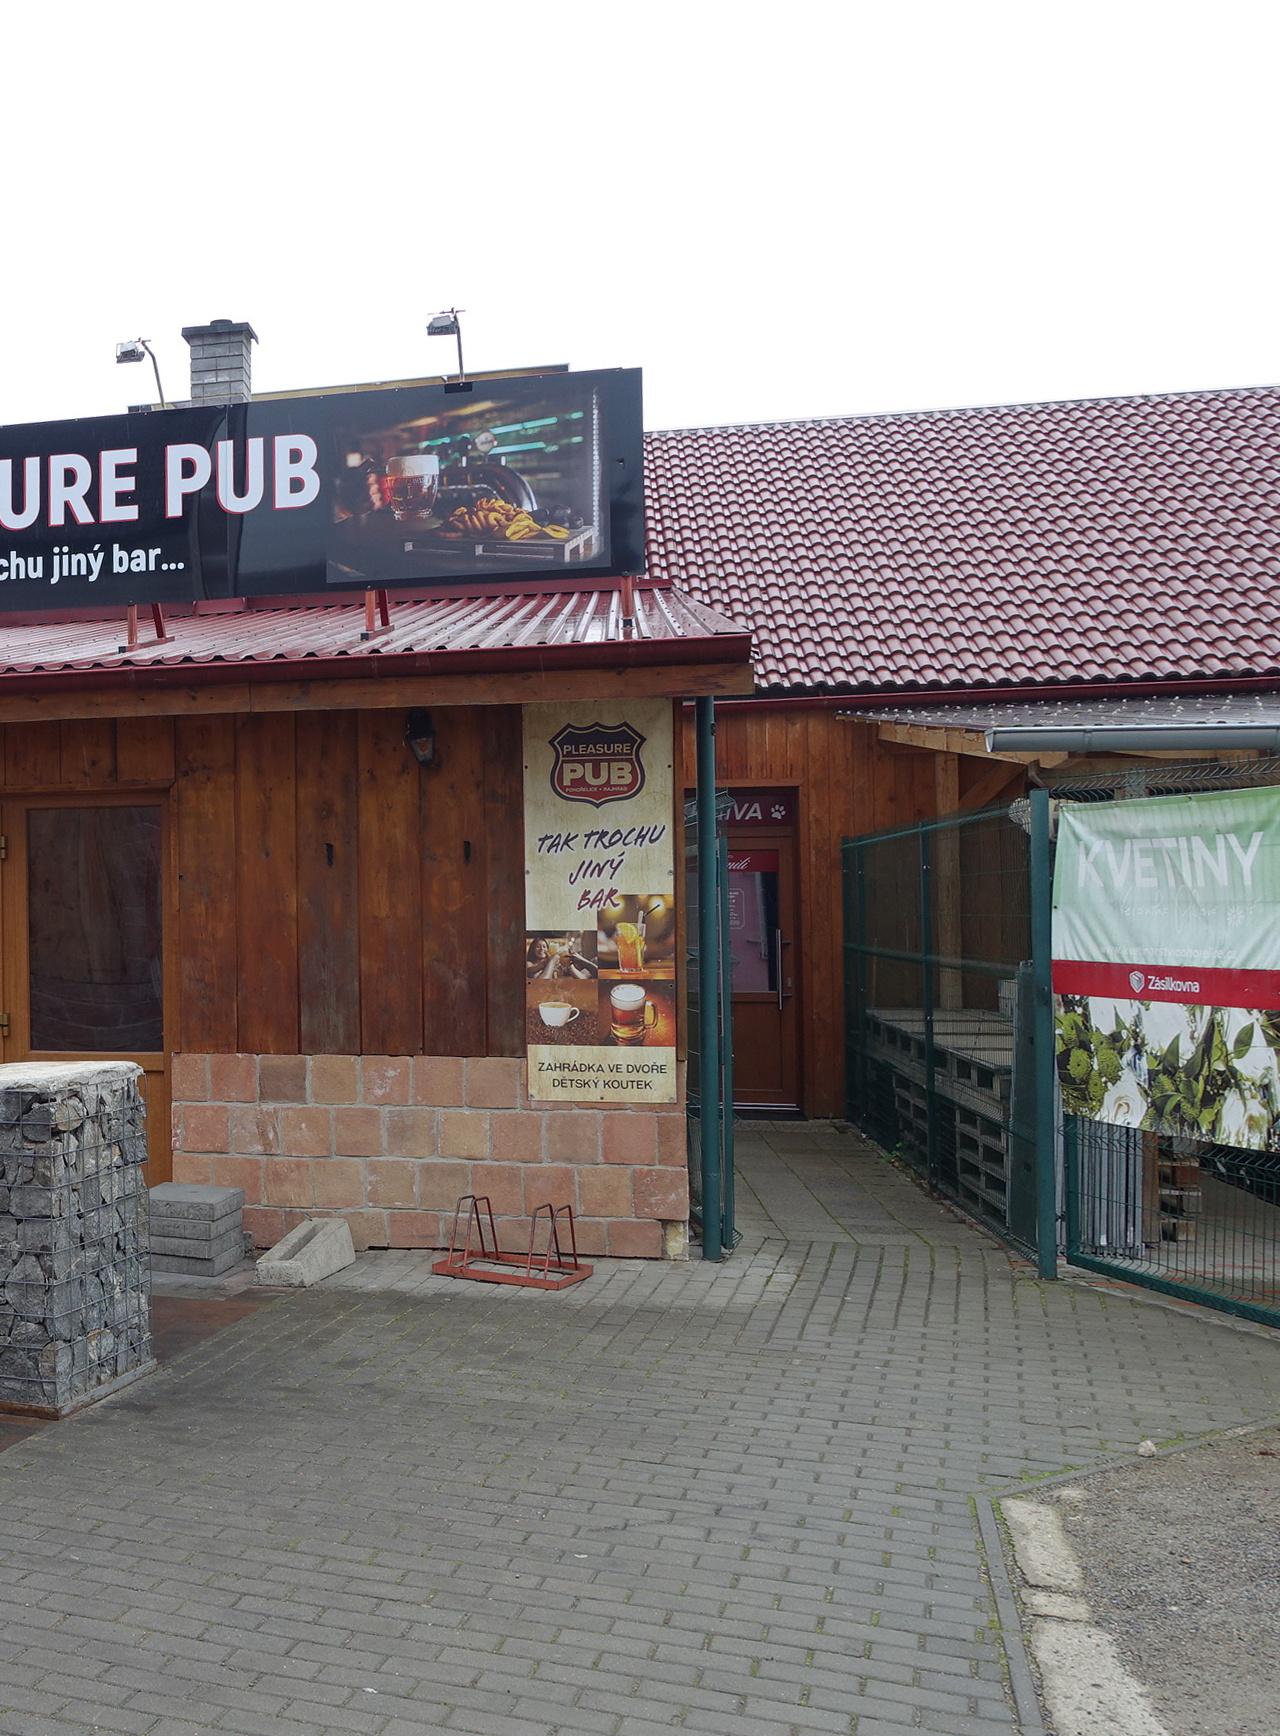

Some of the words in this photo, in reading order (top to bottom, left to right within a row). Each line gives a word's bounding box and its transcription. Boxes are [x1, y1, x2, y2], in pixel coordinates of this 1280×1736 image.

[164, 433, 321, 519] PUB
[51, 546, 106, 583] jiný
[113, 542, 185, 575] bar...
[563, 743, 631, 756] PLEASURE
[563, 761, 633, 786] PUB
[538, 832, 579, 853] TAK
[583, 825, 666, 850] TROCHU
[569, 851, 625, 885] JINÝ
[577, 887, 620, 911] BAR
[1147, 975, 1200, 993] Zásilkovna
[538, 1060, 605, 1073] ZAHRÁDKA
[607, 1064, 623, 1073] VE
[626, 1061, 668, 1074] DVOŘE
[552, 1076, 600, 1089] DĚTSKÝ
[603, 1079, 653, 1090] KOUTEK
